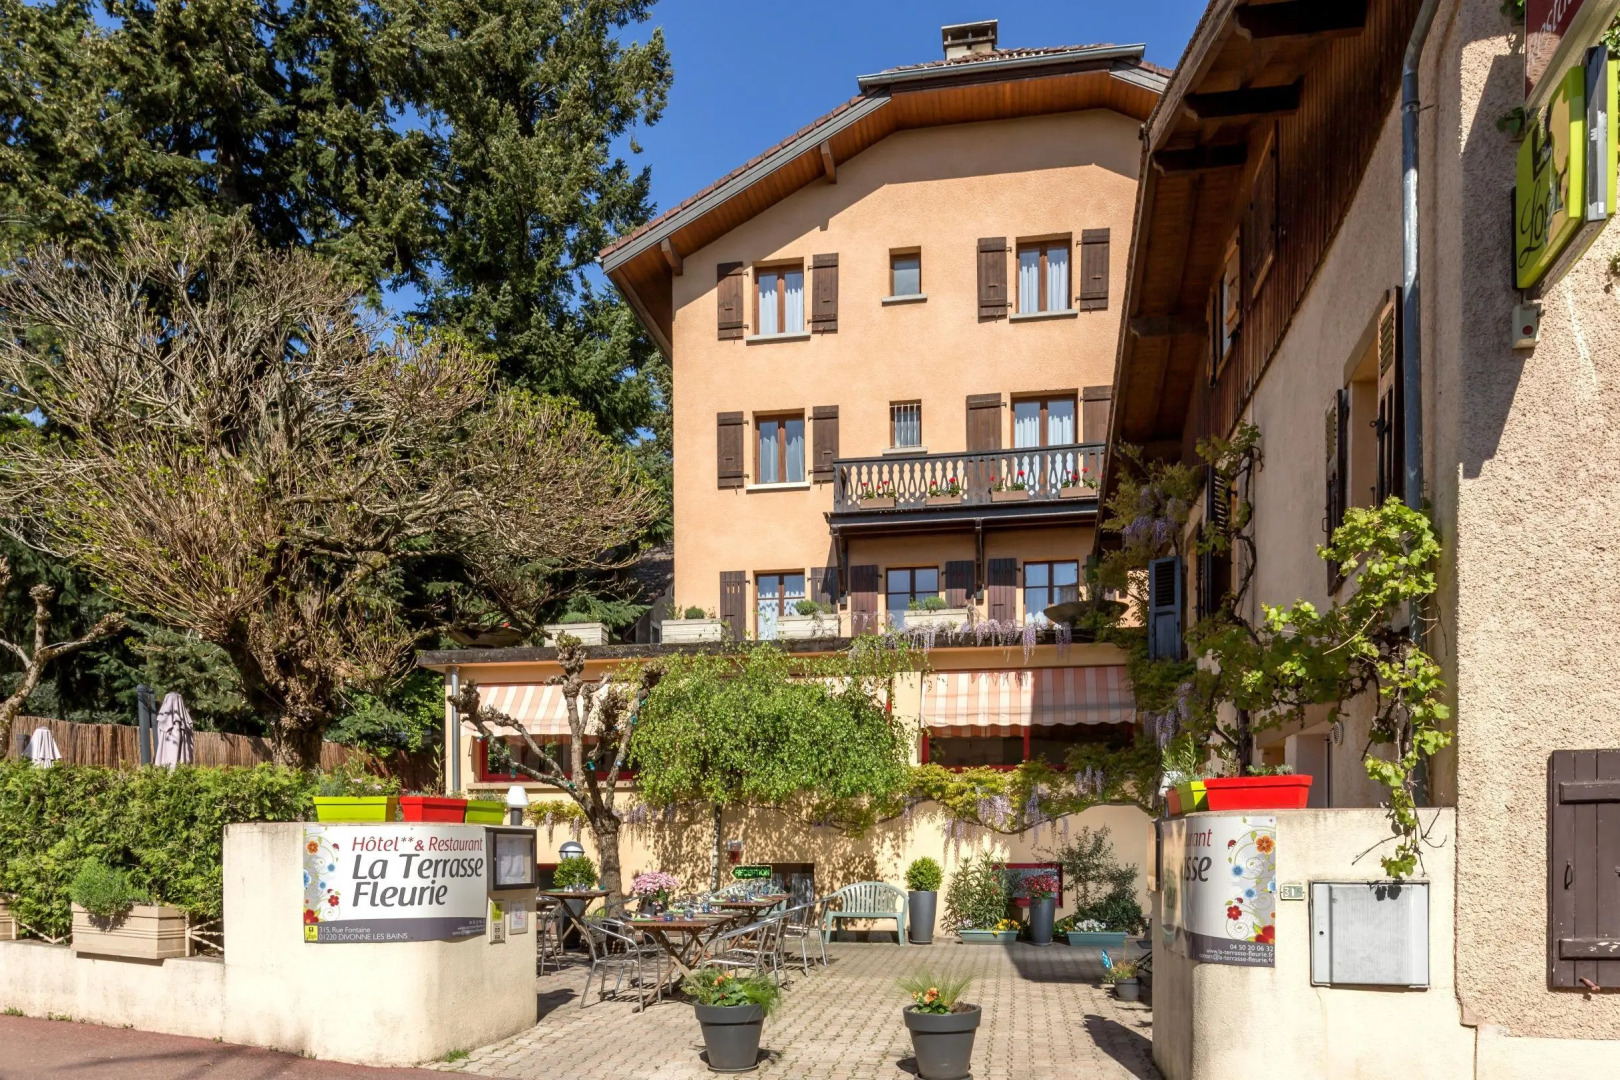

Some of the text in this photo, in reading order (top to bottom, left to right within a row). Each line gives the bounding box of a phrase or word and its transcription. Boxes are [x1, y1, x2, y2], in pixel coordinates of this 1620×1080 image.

[414, 839, 425, 852] &
[428, 836, 484, 852] Restaurant
[352, 853, 484, 880] La Terrasse
[735, 868, 770, 877] RECEPTION
[352, 879, 448, 907] Fleurie
[319, 926, 330, 934] 315,
[386, 932, 408, 940] BAINS
